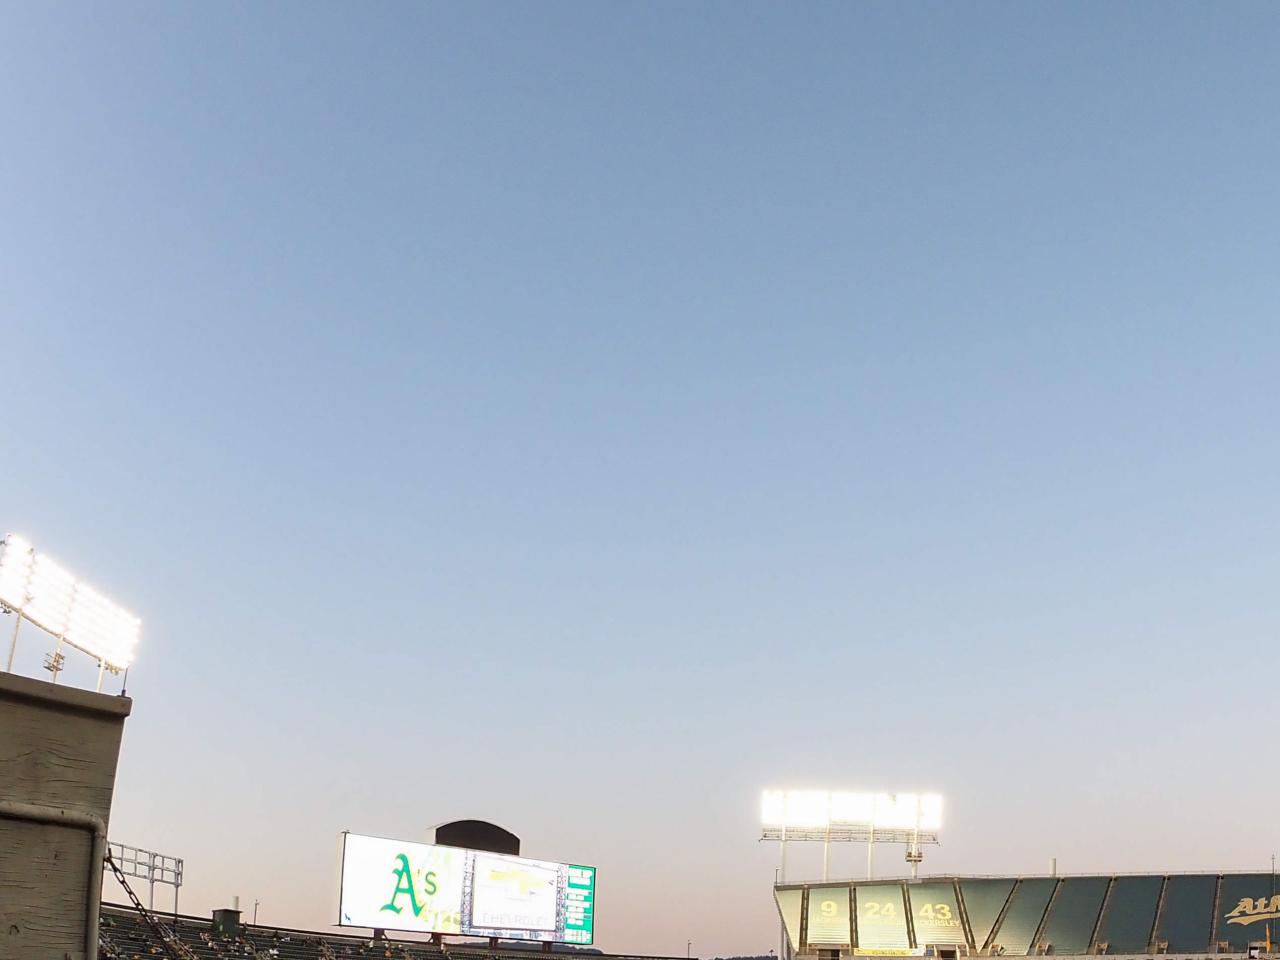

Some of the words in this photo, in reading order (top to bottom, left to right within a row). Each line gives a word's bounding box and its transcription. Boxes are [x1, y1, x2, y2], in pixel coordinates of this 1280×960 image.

[380, 853, 437, 917] A's
[821, 901, 838, 917] 9
[864, 902, 897, 917] 24
[919, 903, 952, 919] 43
